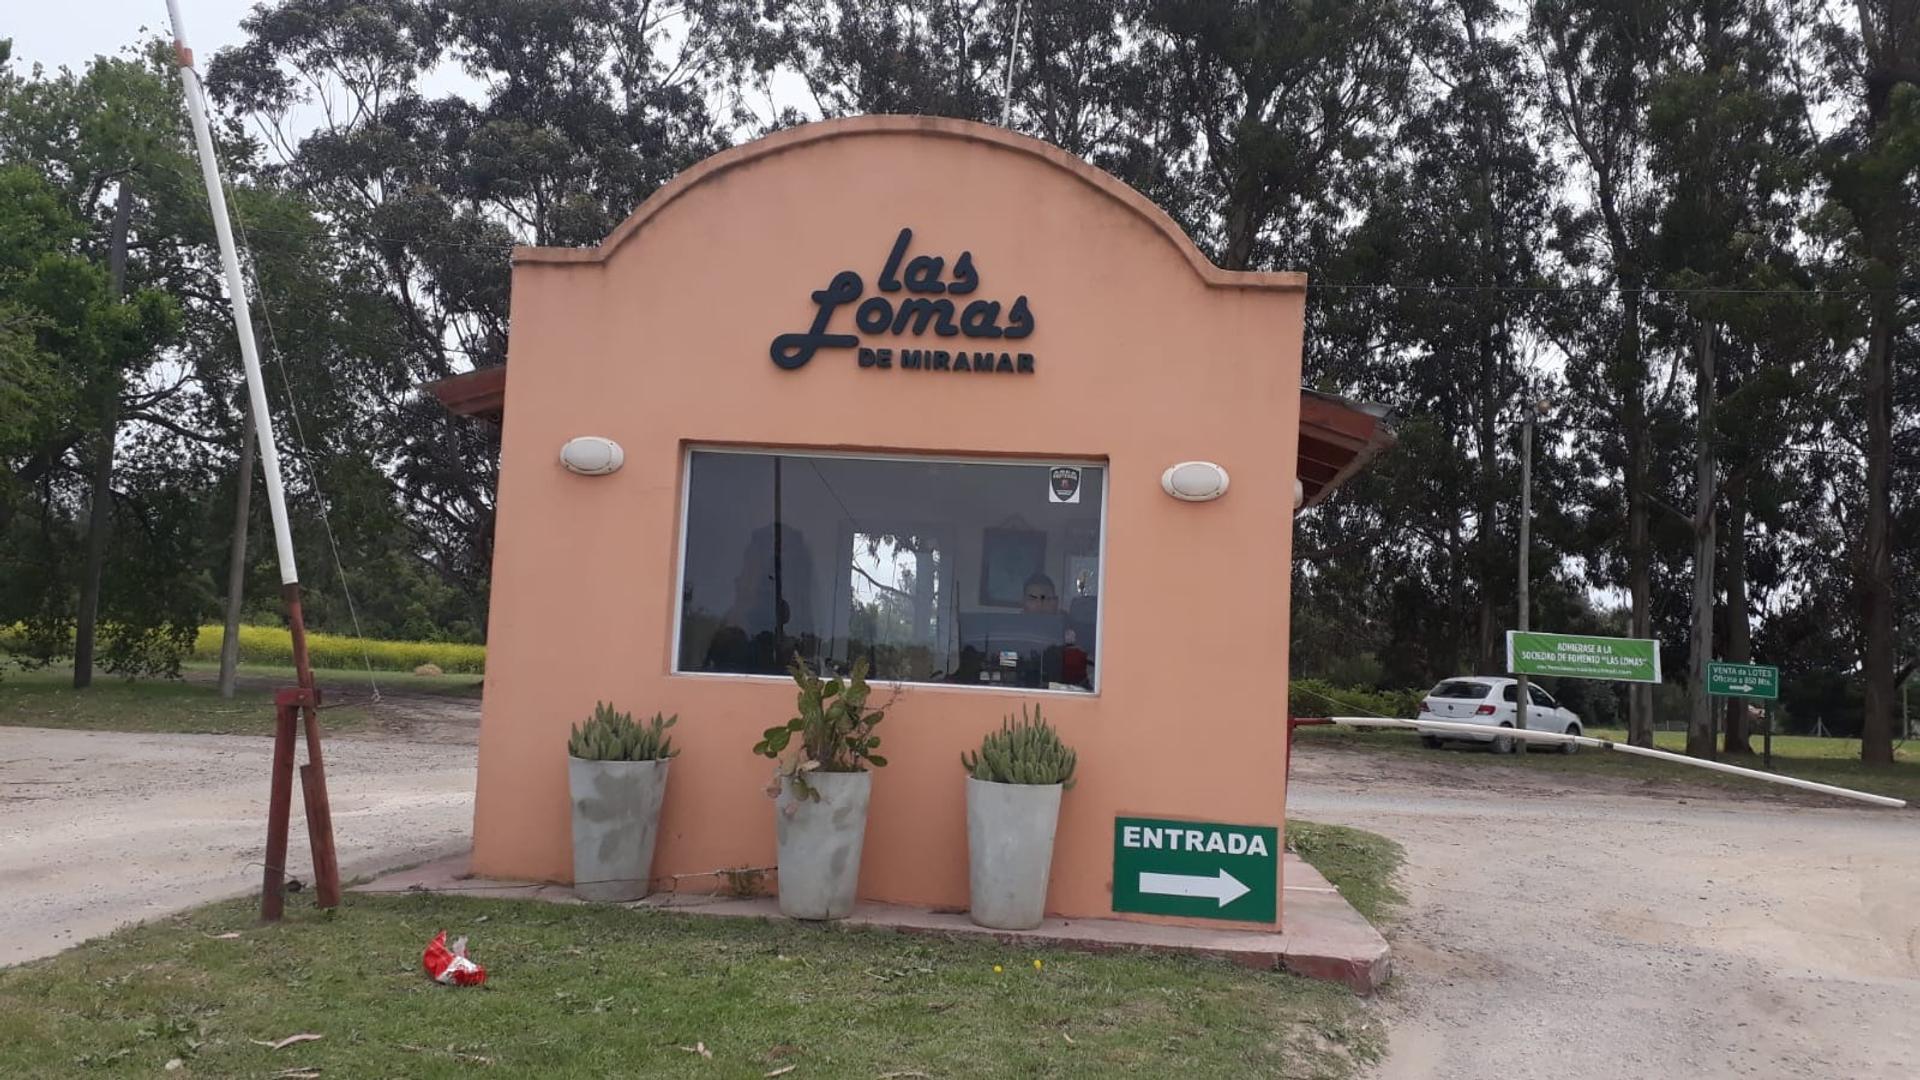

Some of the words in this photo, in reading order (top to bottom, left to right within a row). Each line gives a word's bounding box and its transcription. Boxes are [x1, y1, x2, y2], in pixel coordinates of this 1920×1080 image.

[770, 271, 1035, 370] Lomas
[858, 347, 892, 369] DE
[901, 349, 1035, 374] MIRAMAR
[1603, 645, 1612, 654] LA
[1521, 651, 1556, 661] SOCIEDAD
[1557, 653, 1567, 662] DE
[1568, 653, 1600, 664] FOMENTO
[1713, 666, 1737, 675] VENTA
[1748, 668, 1773, 677] LOTES
[1713, 675, 1738, 683] Oficina
[1123, 825, 1269, 857] ENTRADA
